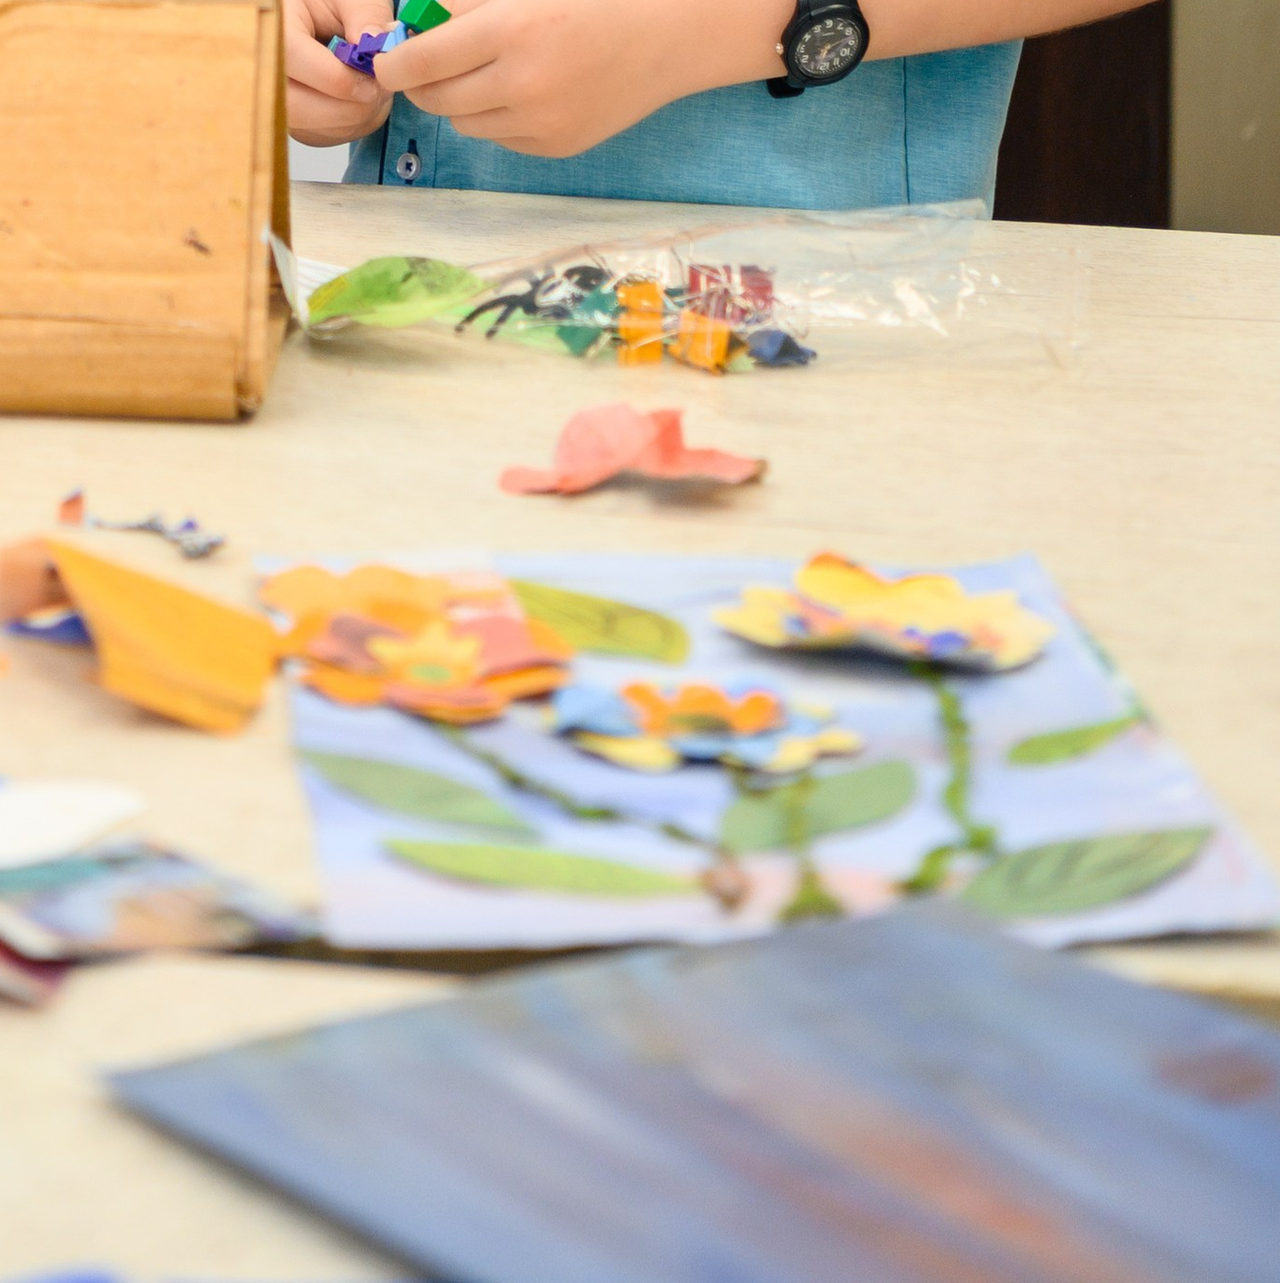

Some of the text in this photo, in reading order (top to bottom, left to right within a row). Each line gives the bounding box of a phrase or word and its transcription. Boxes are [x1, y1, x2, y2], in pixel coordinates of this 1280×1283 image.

[837, 22, 844, 30] 7
[845, 27, 853, 35] 8
[840, 47, 850, 56] 10
[802, 55, 808, 63] 2
[834, 58, 840, 66] 11
[820, 62, 829, 71] 12
